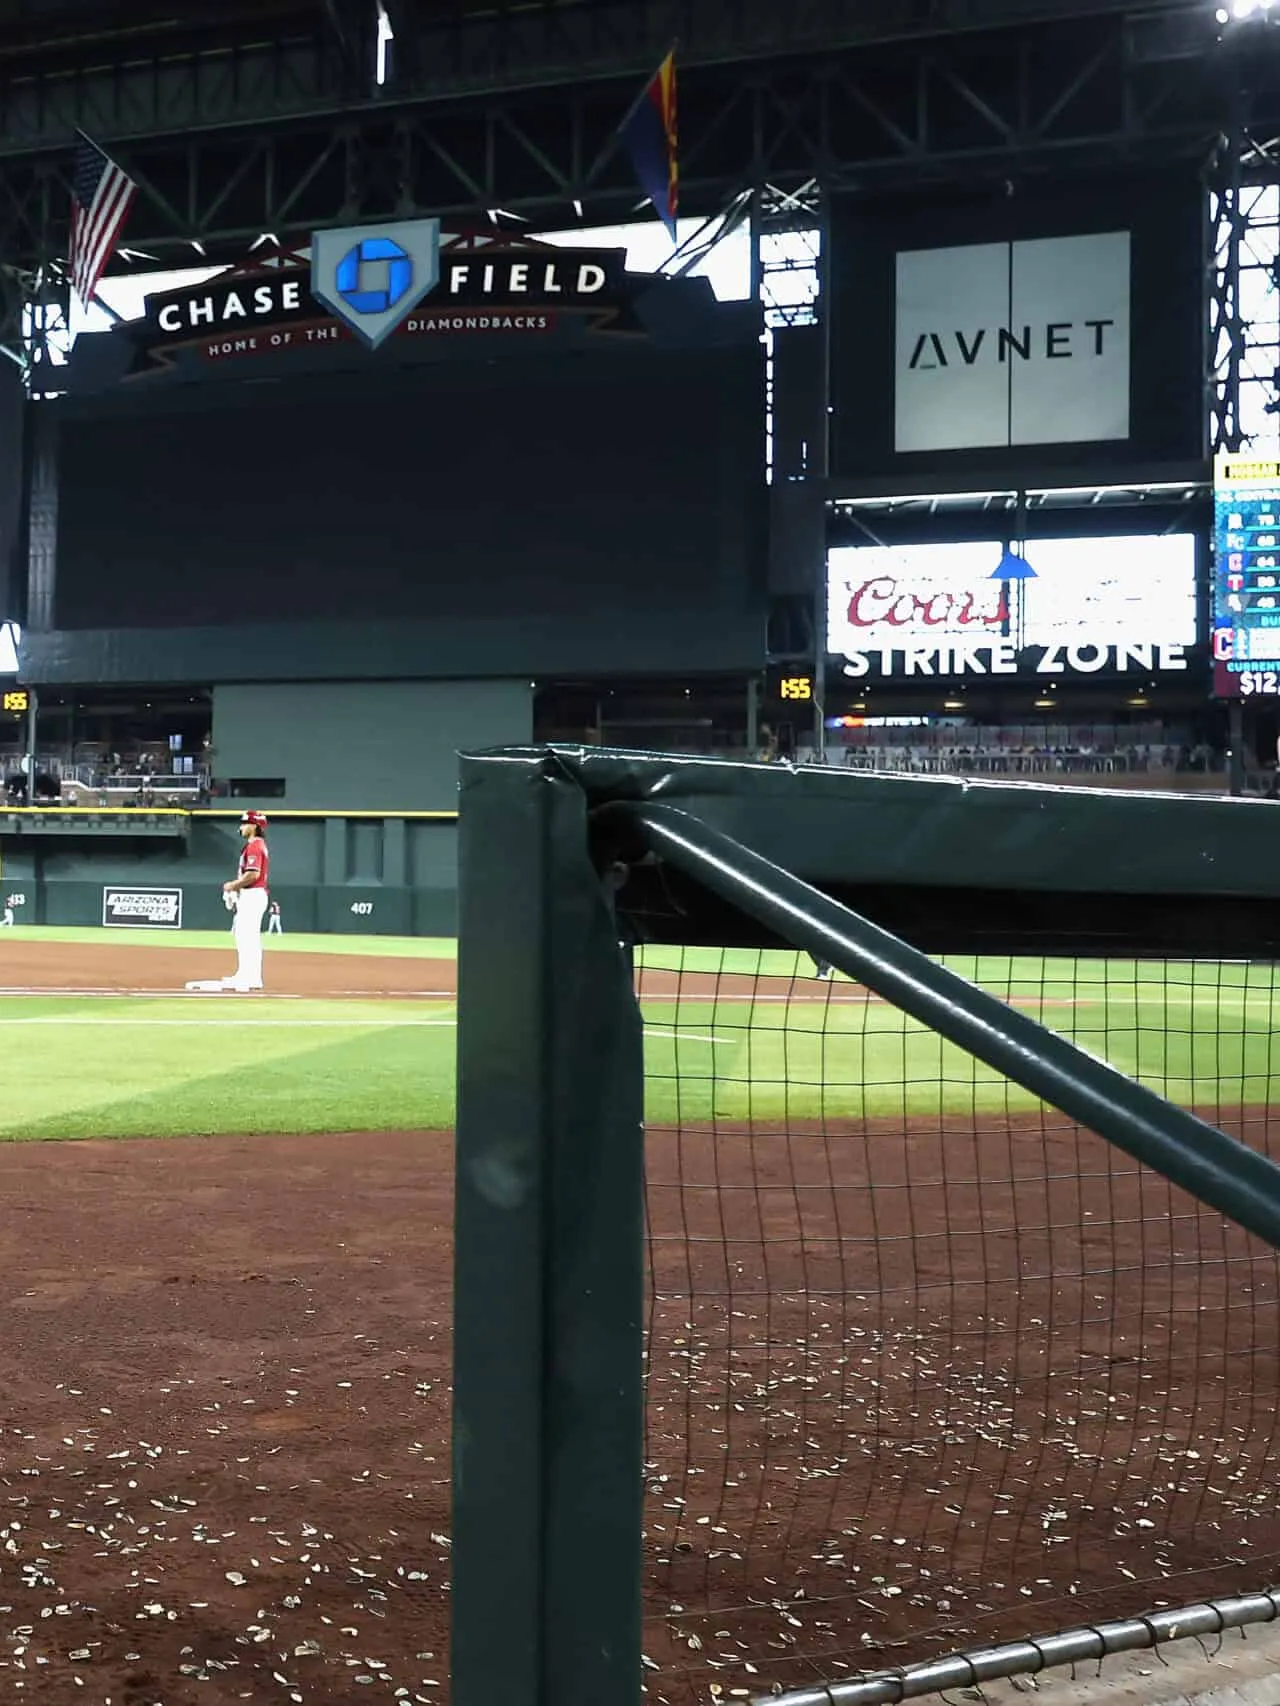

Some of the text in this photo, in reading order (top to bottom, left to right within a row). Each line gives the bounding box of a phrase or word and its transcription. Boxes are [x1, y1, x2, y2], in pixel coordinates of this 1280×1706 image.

[158, 263, 606, 332] CHASE FIELD
[208, 316, 547, 357] HOME OF THE DIAMONDBACKS
[908, 319, 1115, 369] AVNET
[842, 640, 1188, 677] STRIKE ZONE
[350, 902, 374, 915] 407
